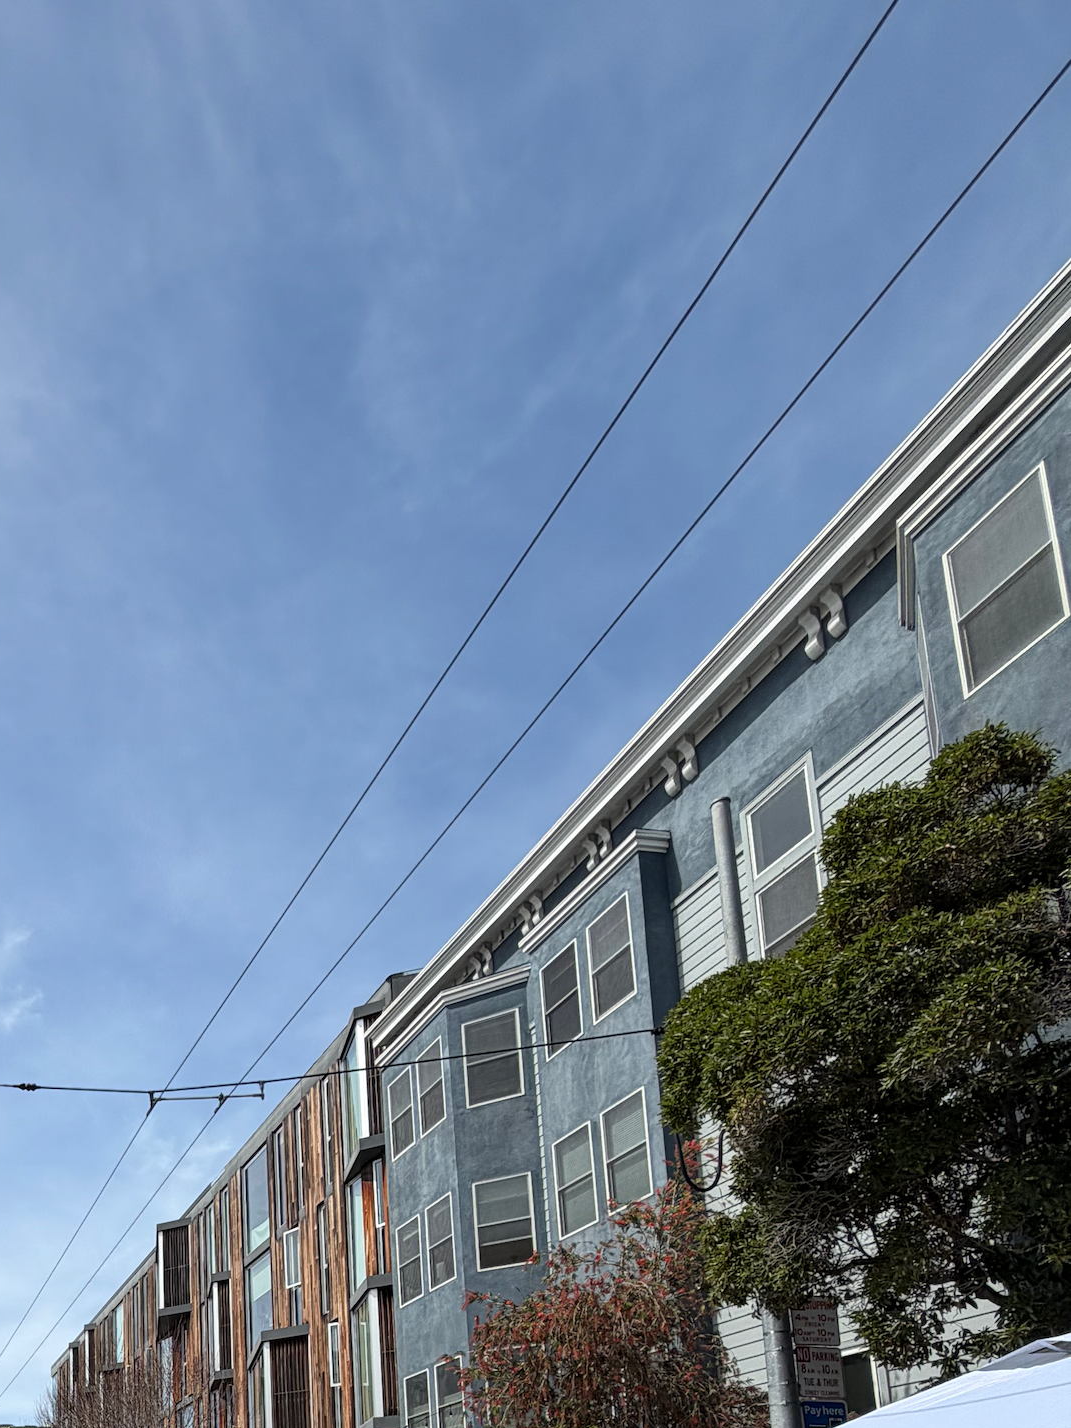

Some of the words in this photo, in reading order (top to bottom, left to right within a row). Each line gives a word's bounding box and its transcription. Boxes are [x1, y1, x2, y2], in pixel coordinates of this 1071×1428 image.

[797, 1347, 809, 1361] NO
[812, 1351, 840, 1362] PARKING
[804, 1404, 821, 1417] Pay
[822, 1405, 844, 1416] here
